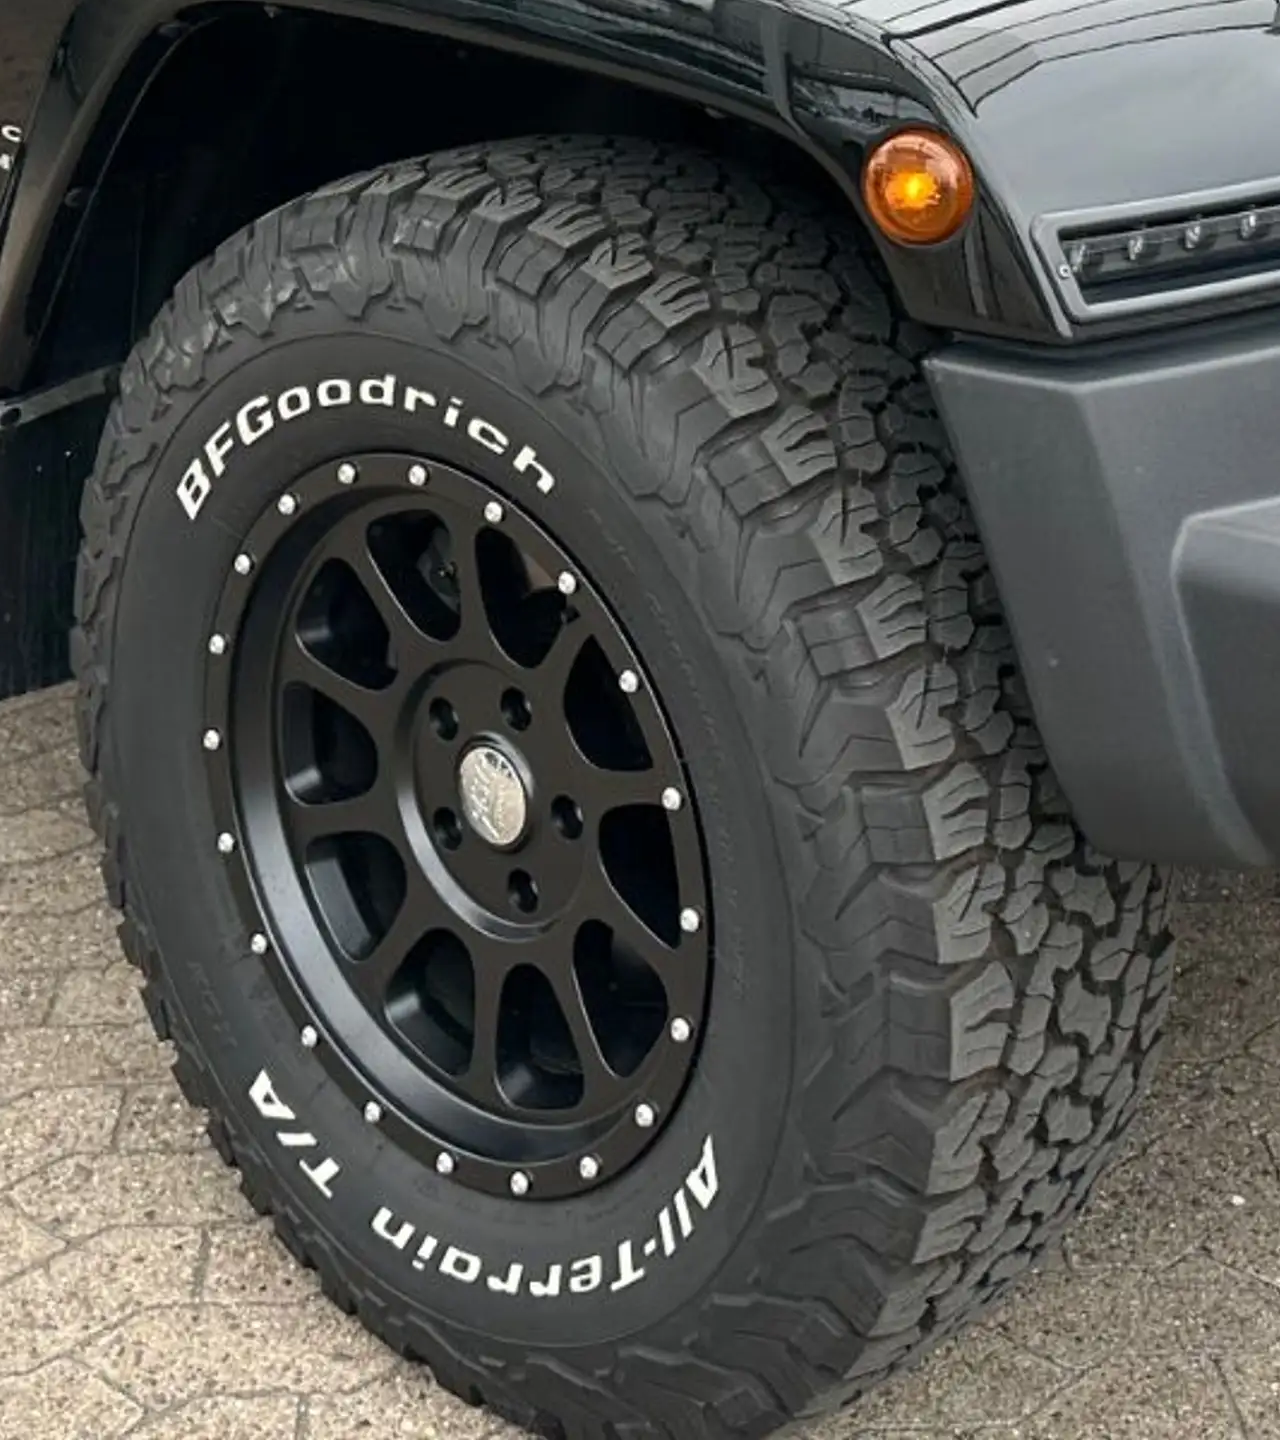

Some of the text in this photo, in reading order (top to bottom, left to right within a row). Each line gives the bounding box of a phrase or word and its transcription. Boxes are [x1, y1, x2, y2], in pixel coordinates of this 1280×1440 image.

[175, 374, 556, 521] BFGoodrich
[248, 1068, 720, 1297] All-Terrain T/A
